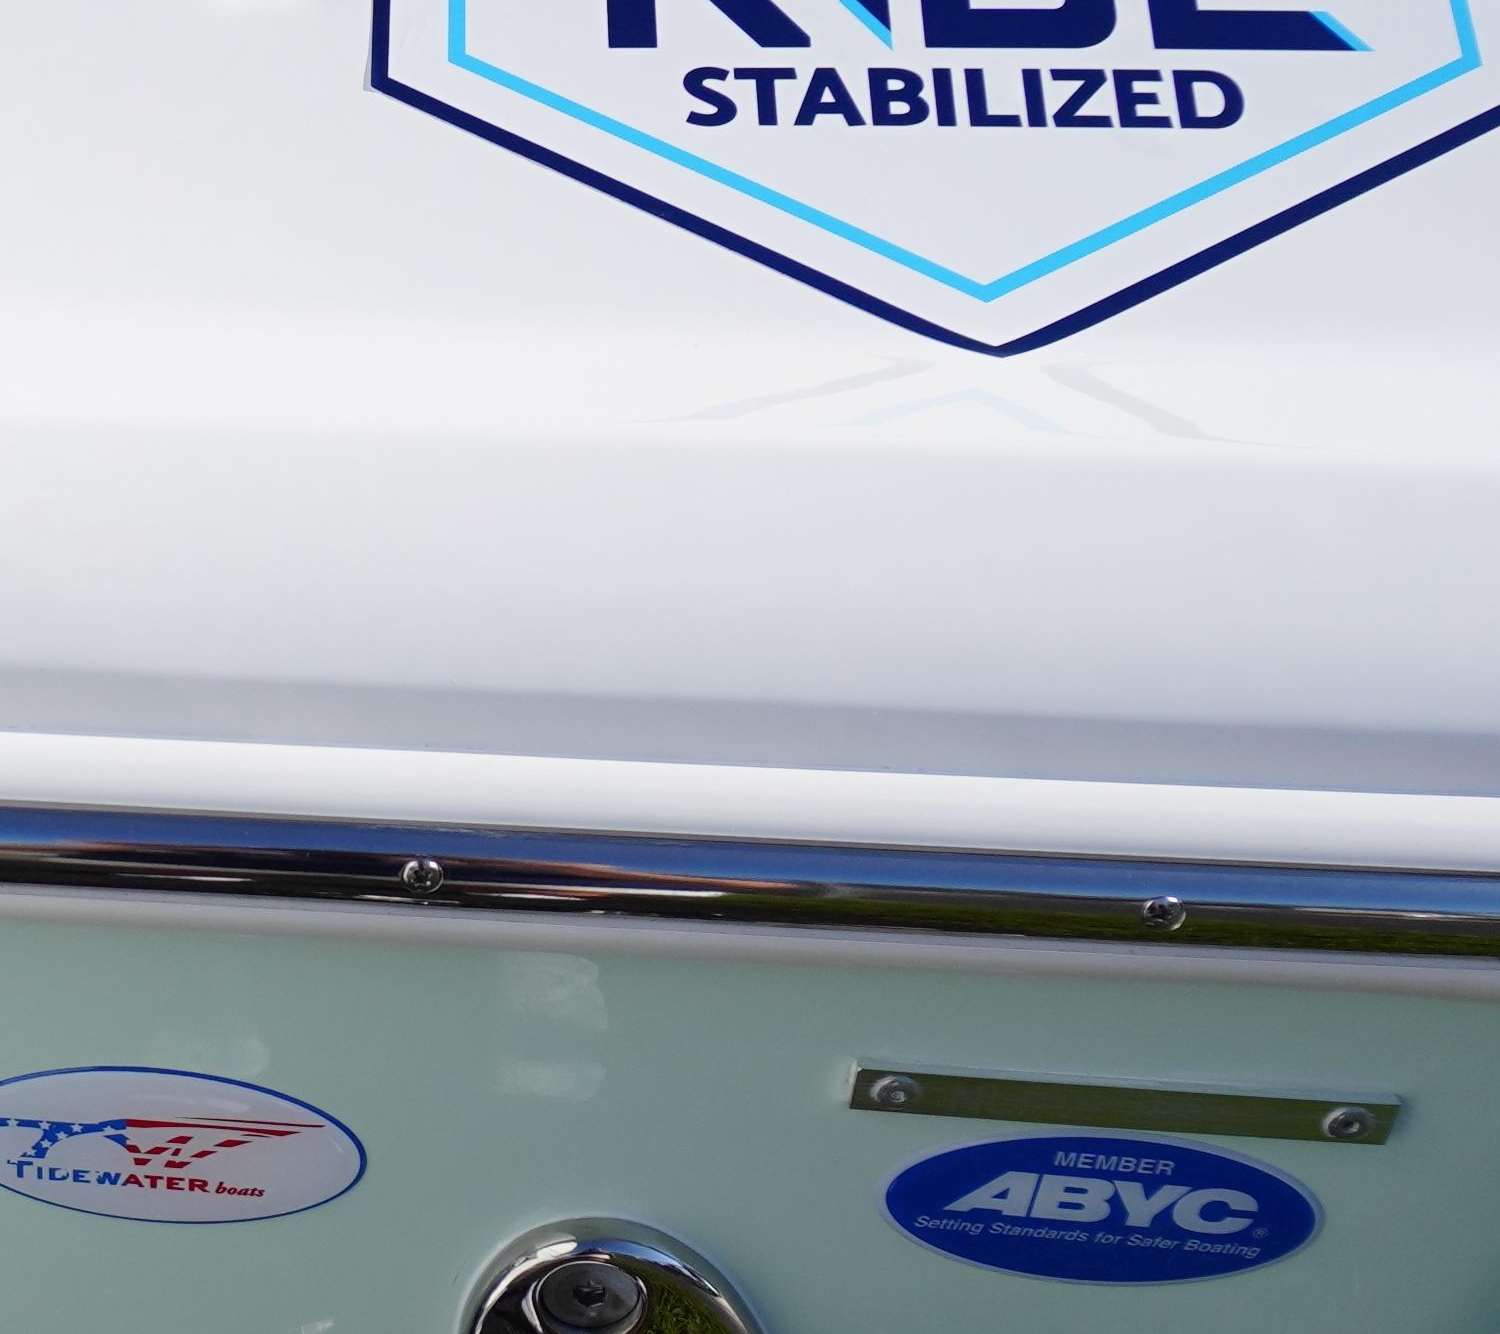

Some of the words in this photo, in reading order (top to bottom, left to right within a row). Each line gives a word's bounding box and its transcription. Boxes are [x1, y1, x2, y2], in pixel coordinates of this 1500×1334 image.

[681, 65, 1246, 130] STABILIZED
[1053, 1150, 1177, 1176] MEMBER
[214, 1180, 266, 1199] boats
[942, 1170, 1260, 1235] ABYC
[913, 1215, 984, 1236] Setting
[987, 1221, 1089, 1243] Standards
[1094, 1232, 1121, 1245] for
[1126, 1233, 1180, 1251] Safer
[1183, 1239, 1262, 1260] Boating
